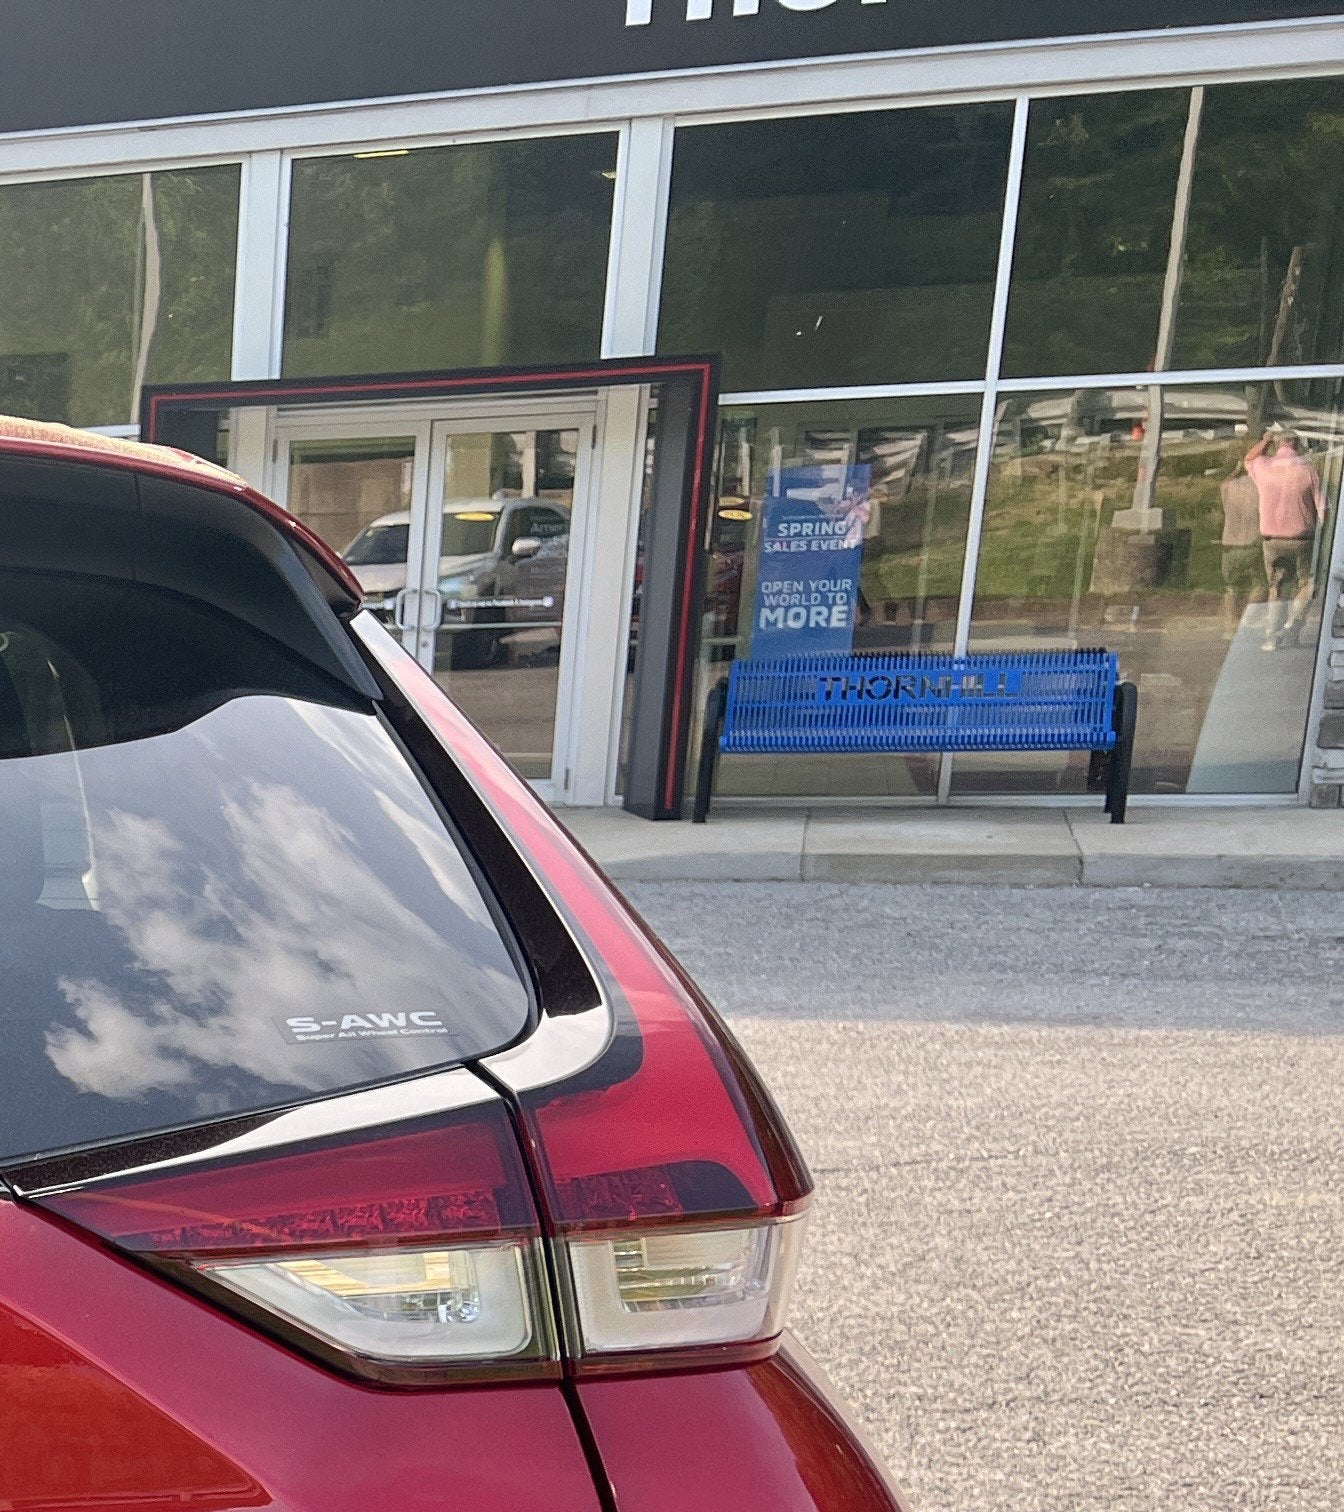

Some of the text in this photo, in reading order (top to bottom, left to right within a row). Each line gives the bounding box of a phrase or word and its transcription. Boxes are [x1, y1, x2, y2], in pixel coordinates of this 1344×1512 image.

[777, 520, 847, 537] SPRING
[764, 539, 807, 553] SALES
[761, 578, 852, 593] OPEN YOUR
[763, 591, 848, 607] WORLD TO
[759, 604, 850, 630] MORE
[819, 672, 1019, 701] THORNHILL
[285, 1011, 443, 1033] S-AWC
